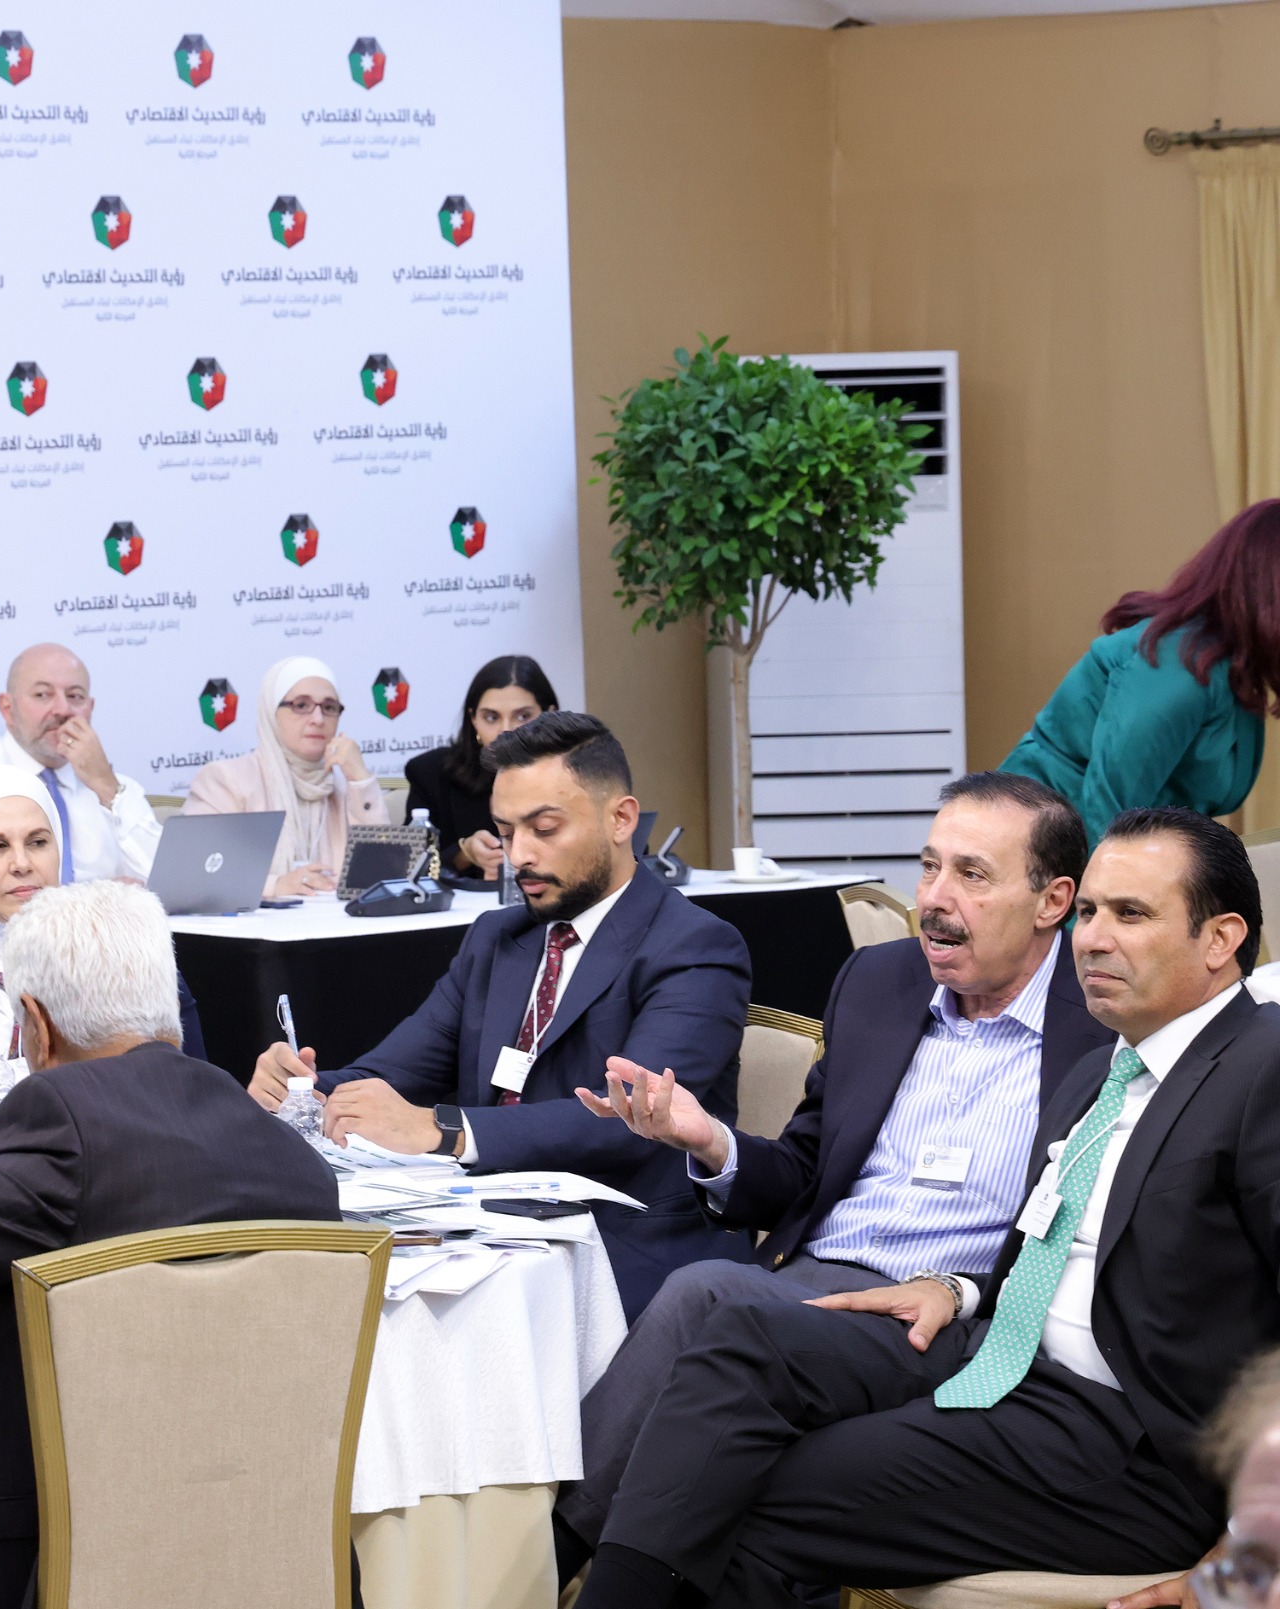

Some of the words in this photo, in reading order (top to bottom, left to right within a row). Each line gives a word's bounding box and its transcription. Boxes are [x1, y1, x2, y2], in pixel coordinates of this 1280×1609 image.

[11, 104, 60, 123] التحديث
[63, 105, 88, 124] رؤية
[125, 106, 188, 125] الاقتصادي
[191, 107, 239, 125] التحديث
[241, 106, 266, 125] رؤية
[301, 107, 362, 126] الاقتصادي
[364, 108, 410, 126] التحديث
[412, 108, 435, 127] رؤية
[42, 268, 106, 288] الاقتصادي
[109, 268, 157, 287] التحديث
[160, 268, 185, 287] رؤية
[221, 266, 283, 286] الاقتصادي
[285, 266, 332, 285] التحديث
[334, 266, 358, 284] رؤية
[392, 265, 451, 284] الاقتصادي
[454, 264, 499, 283] التحديث
[501, 264, 523, 282] رؤية
[138, 429, 201, 450] الاقتصادي
[204, 428, 252, 447] التحديث
[254, 427, 278, 446] رؤية
[313, 424, 374, 444] الاقتصادي
[376, 423, 422, 442] التحديث
[424, 422, 447, 440] رؤية
[24, 433, 74, 454] التحديث
[76, 433, 101, 452] رؤية
[346, 581, 370, 600] رؤية
[403, 576, 463, 597] الاقتصادي
[465, 574, 510, 593] التحديث
[512, 573, 536, 591] رؤية
[121, 591, 170, 612] التحديث
[172, 590, 196, 610] رؤية
[232, 585, 294, 606] الاقتصادي
[297, 582, 343, 603] التحديث
[54, 594, 118, 616] الاقتصادي
[150, 749, 213, 773] الاقتصادي
